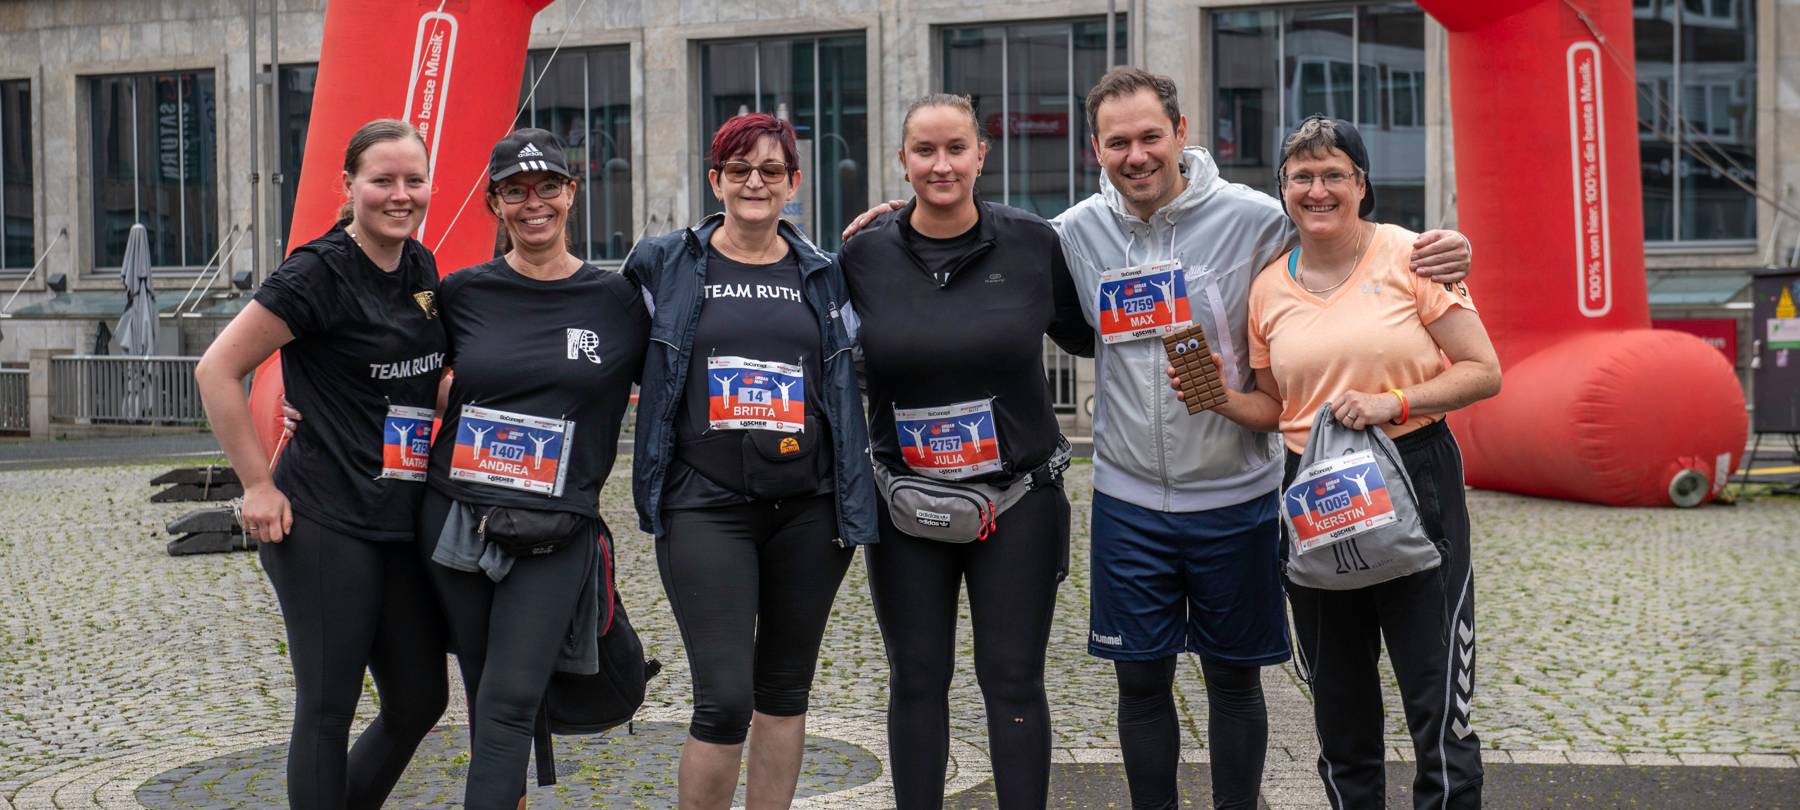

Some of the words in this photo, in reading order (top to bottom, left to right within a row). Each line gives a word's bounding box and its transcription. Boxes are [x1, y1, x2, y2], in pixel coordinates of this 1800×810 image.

[425, 30, 444, 77] Musik.
[1579, 57, 1592, 102] Musik.
[418, 79, 436, 119] beste
[1583, 103, 1595, 141] beste
[1584, 142, 1596, 162] die
[1584, 163, 1597, 203] 100%
[1587, 204, 1599, 233] hier.
[1590, 235, 1601, 259] von
[1189, 264, 1209, 275] NIKE
[1588, 260, 1602, 301] 100%
[704, 284, 752, 299] TEAM
[757, 285, 802, 303] RUTH
[1124, 298, 1154, 314] 2759
[1130, 314, 1155, 327] MAX
[370, 360, 412, 379] TEAM
[412, 352, 446, 376] RUTH
[747, 390, 764, 402] 14
[734, 406, 776, 417] BRITTA
[413, 441, 429, 455] 275
[491, 444, 524, 460] 1407
[931, 438, 960, 452] 2757
[478, 459, 529, 476] ANDREA
[934, 454, 965, 465] JULIA
[1317, 493, 1351, 514] 1005
[918, 512, 939, 520] adidas
[918, 519, 940, 527] adidas
[1315, 507, 1365, 532] KERSTIN
[1092, 630, 1122, 646] hummel
